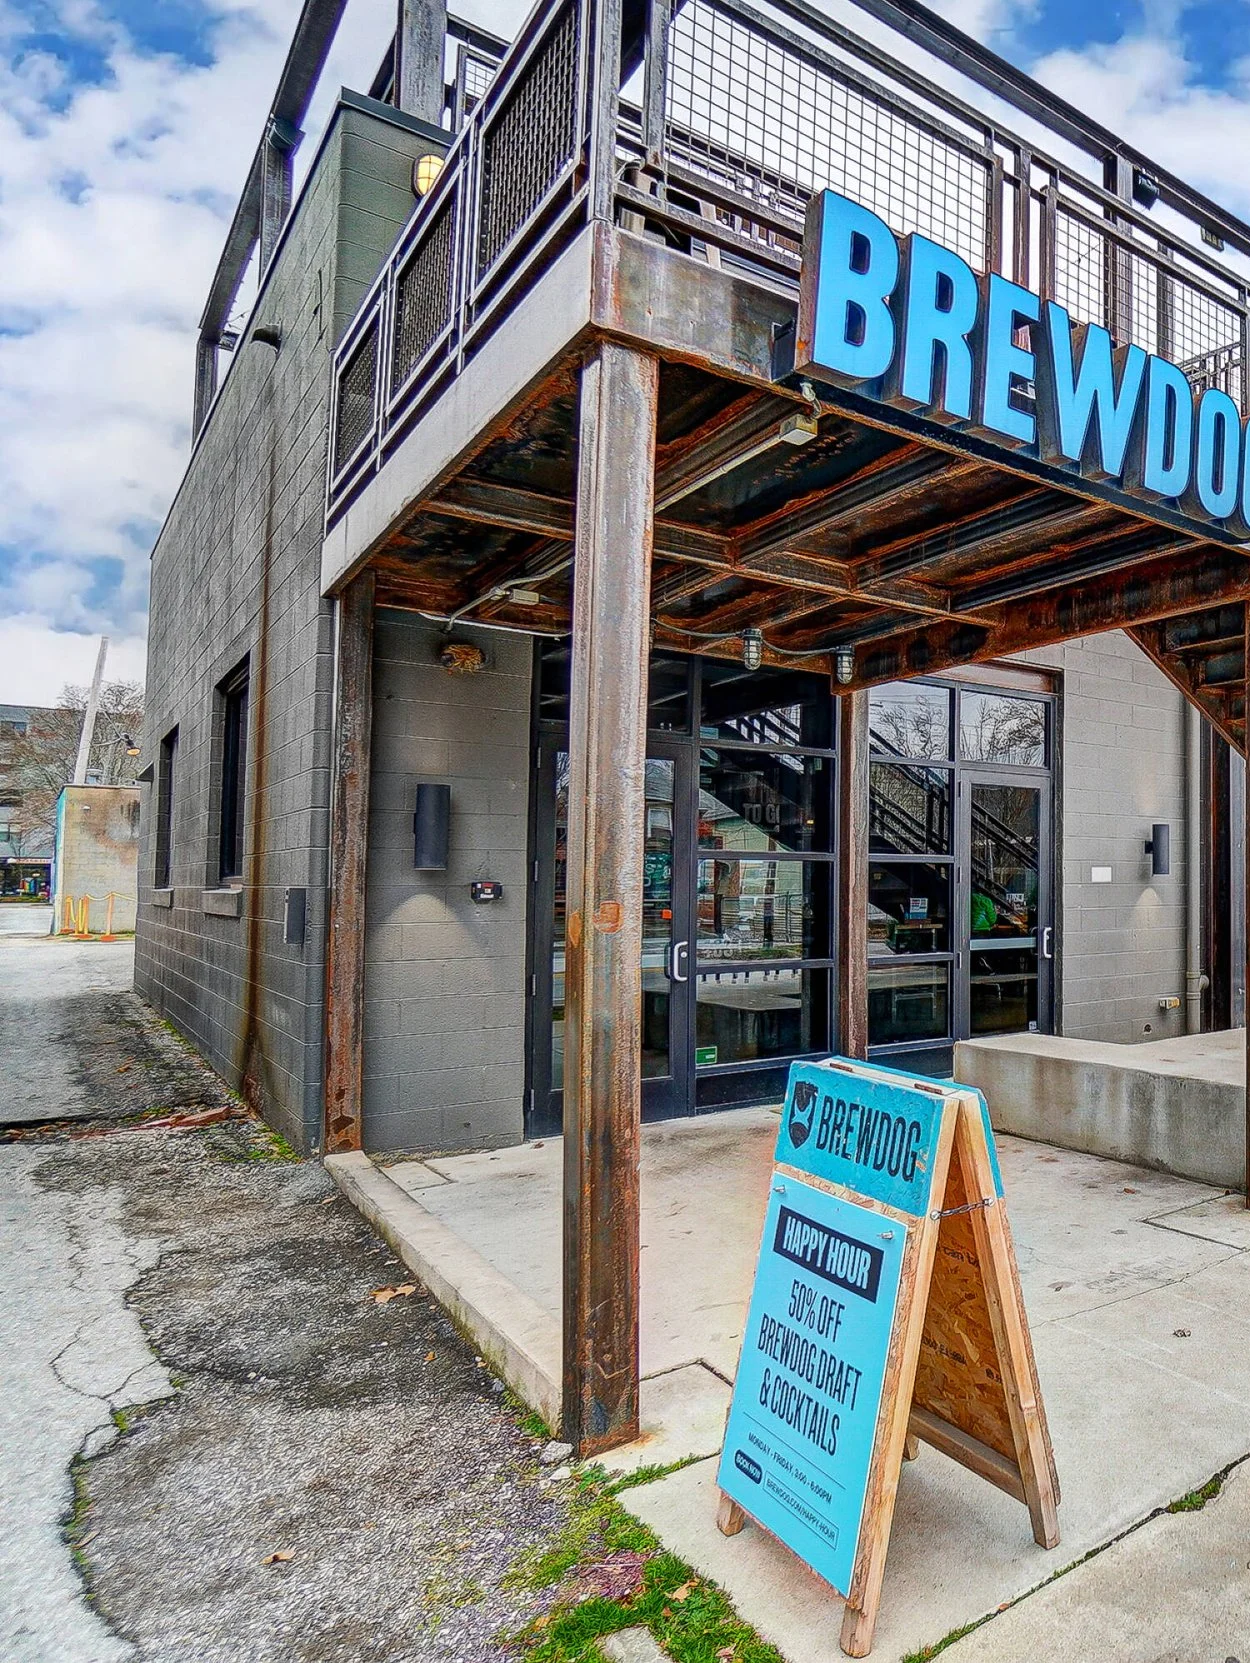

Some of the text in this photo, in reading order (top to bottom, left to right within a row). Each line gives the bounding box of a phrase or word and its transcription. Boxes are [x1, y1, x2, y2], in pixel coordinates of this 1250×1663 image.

[815, 1094, 922, 1184] BREWDOG
[782, 1215, 872, 1290] HAPPY HOUR
[788, 1279, 846, 1343] 50% OFF
[758, 1312, 818, 1384] BREWDOG
[815, 1348, 863, 1411] DRAFT
[748, 1431, 772, 1456] MONDAY
[759, 1367, 840, 1457] & COCKTAILS
[736, 1453, 750, 1471] BOOK
